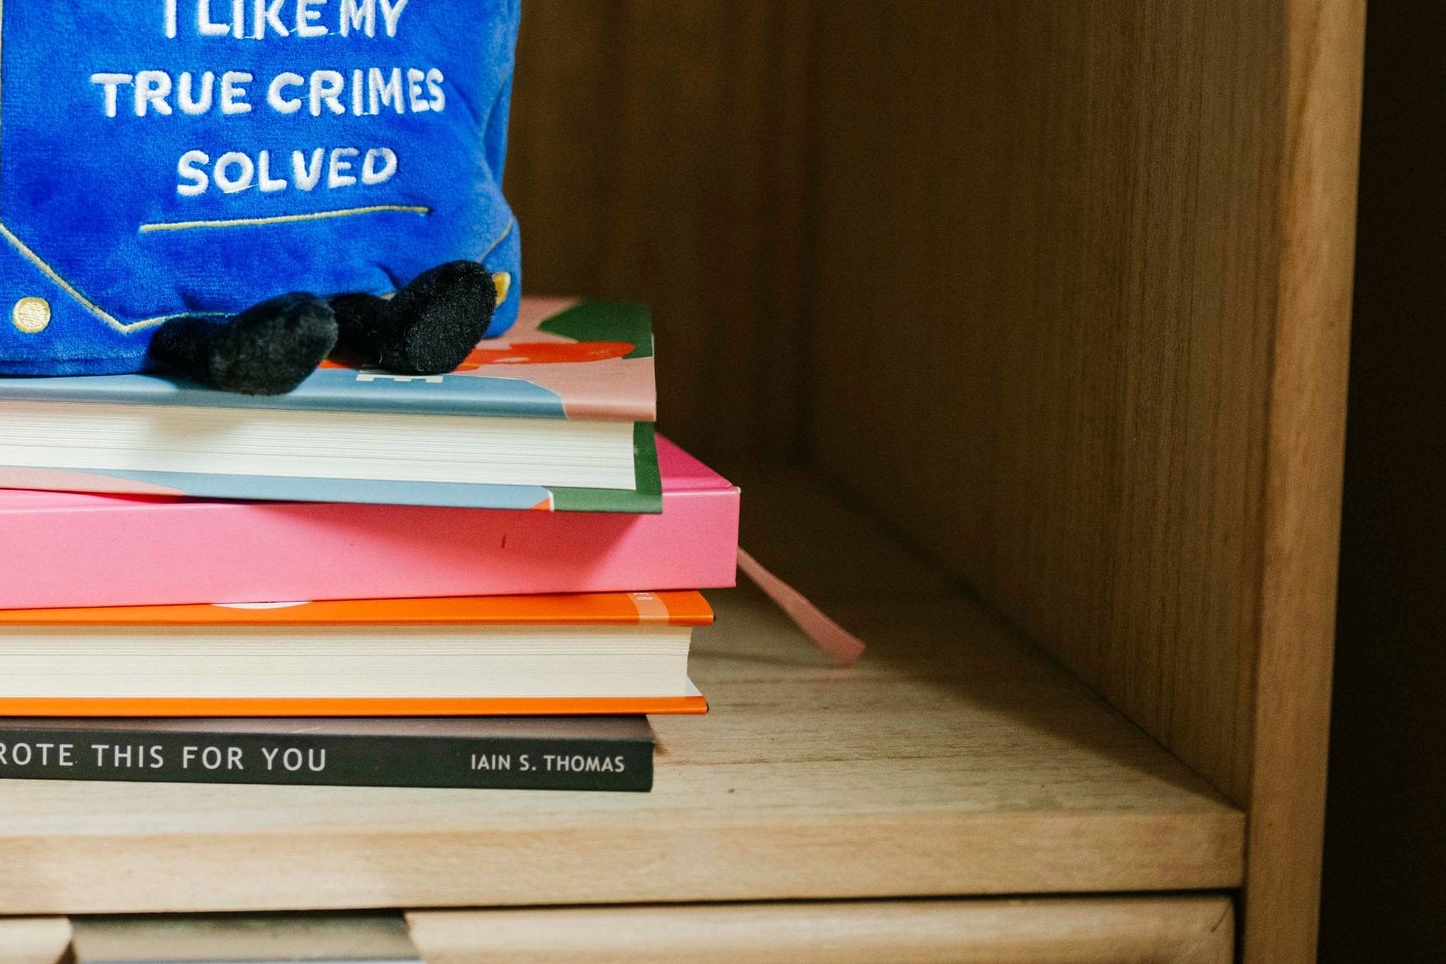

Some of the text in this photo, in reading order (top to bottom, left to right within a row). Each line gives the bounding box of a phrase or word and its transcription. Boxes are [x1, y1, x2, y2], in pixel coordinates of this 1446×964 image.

[91, 67, 446, 118] TRUE CRIMES
[176, 147, 398, 197] SOLVED
[91, 744, 164, 769] THIS
[183, 746, 244, 770] FOR
[261, 747, 327, 772] YOU
[471, 753, 625, 773] IAIN S. THOMAS
